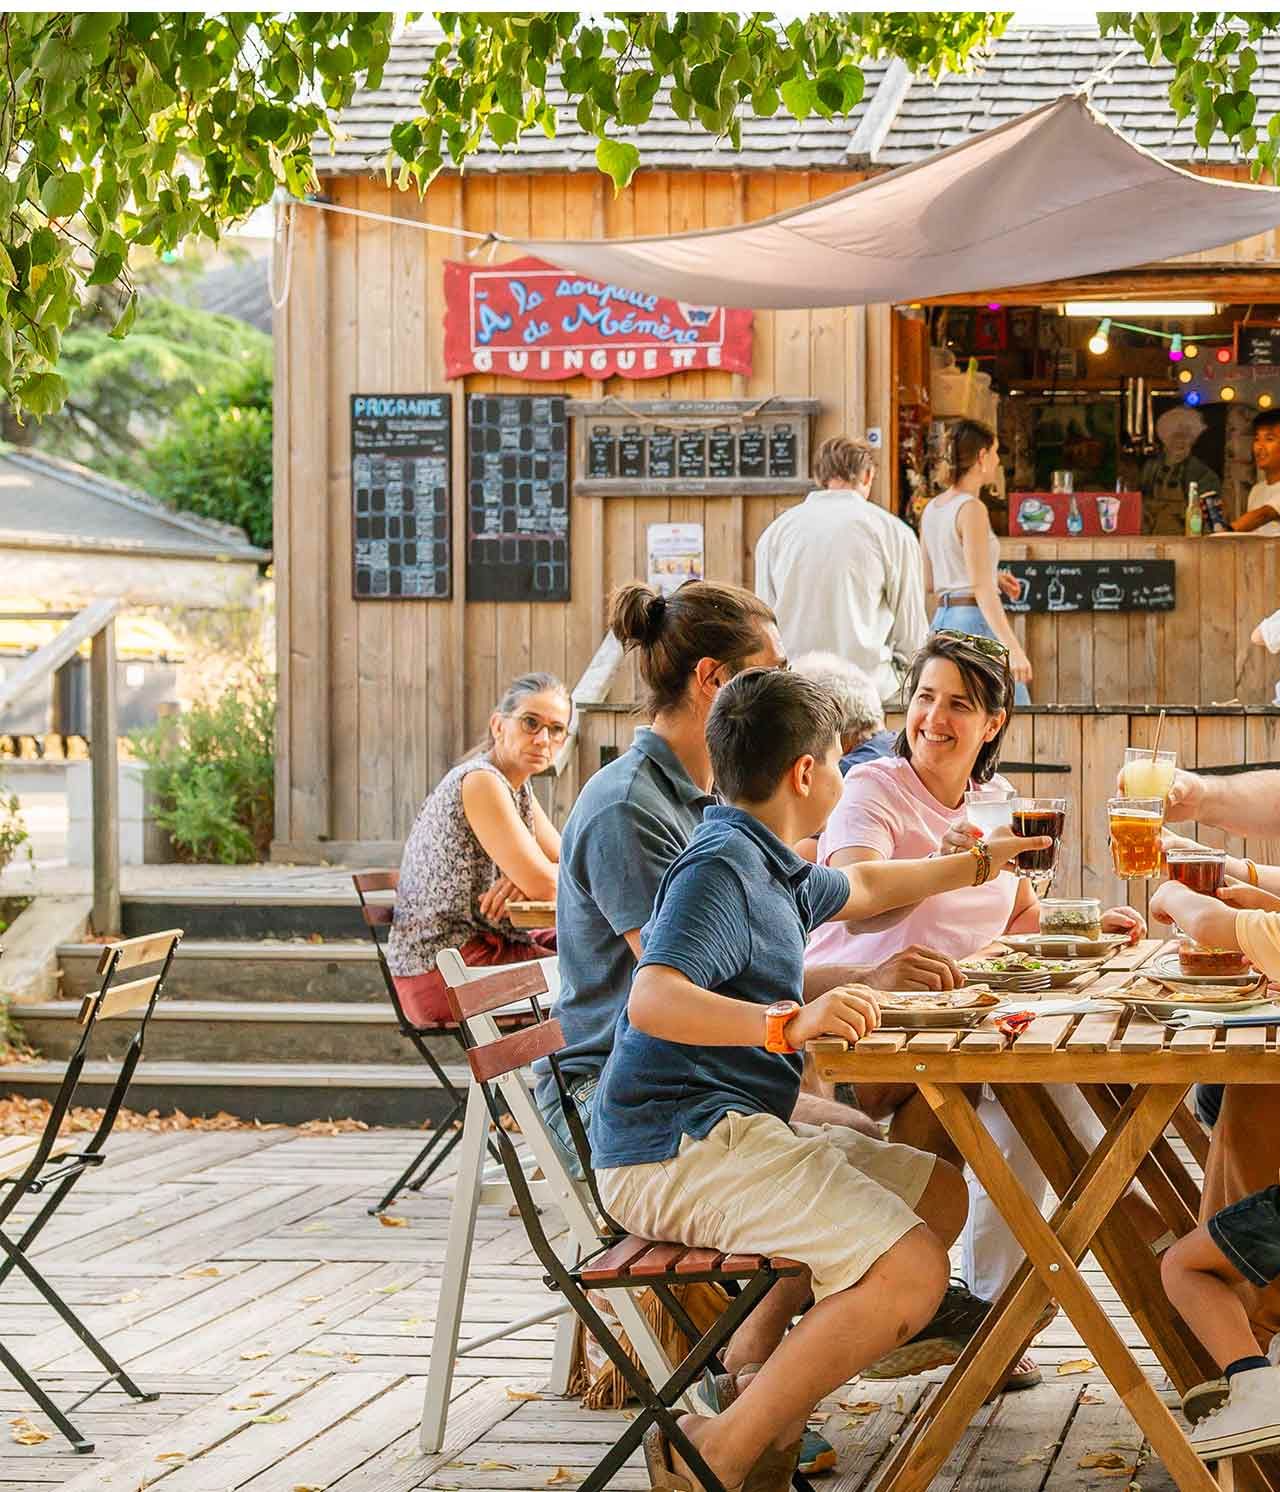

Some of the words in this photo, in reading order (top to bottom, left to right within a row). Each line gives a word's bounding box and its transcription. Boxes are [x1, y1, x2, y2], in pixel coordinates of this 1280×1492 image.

[510, 280, 545, 316] la
[523, 320, 552, 344] de
[562, 303, 700, 345] Mémère
